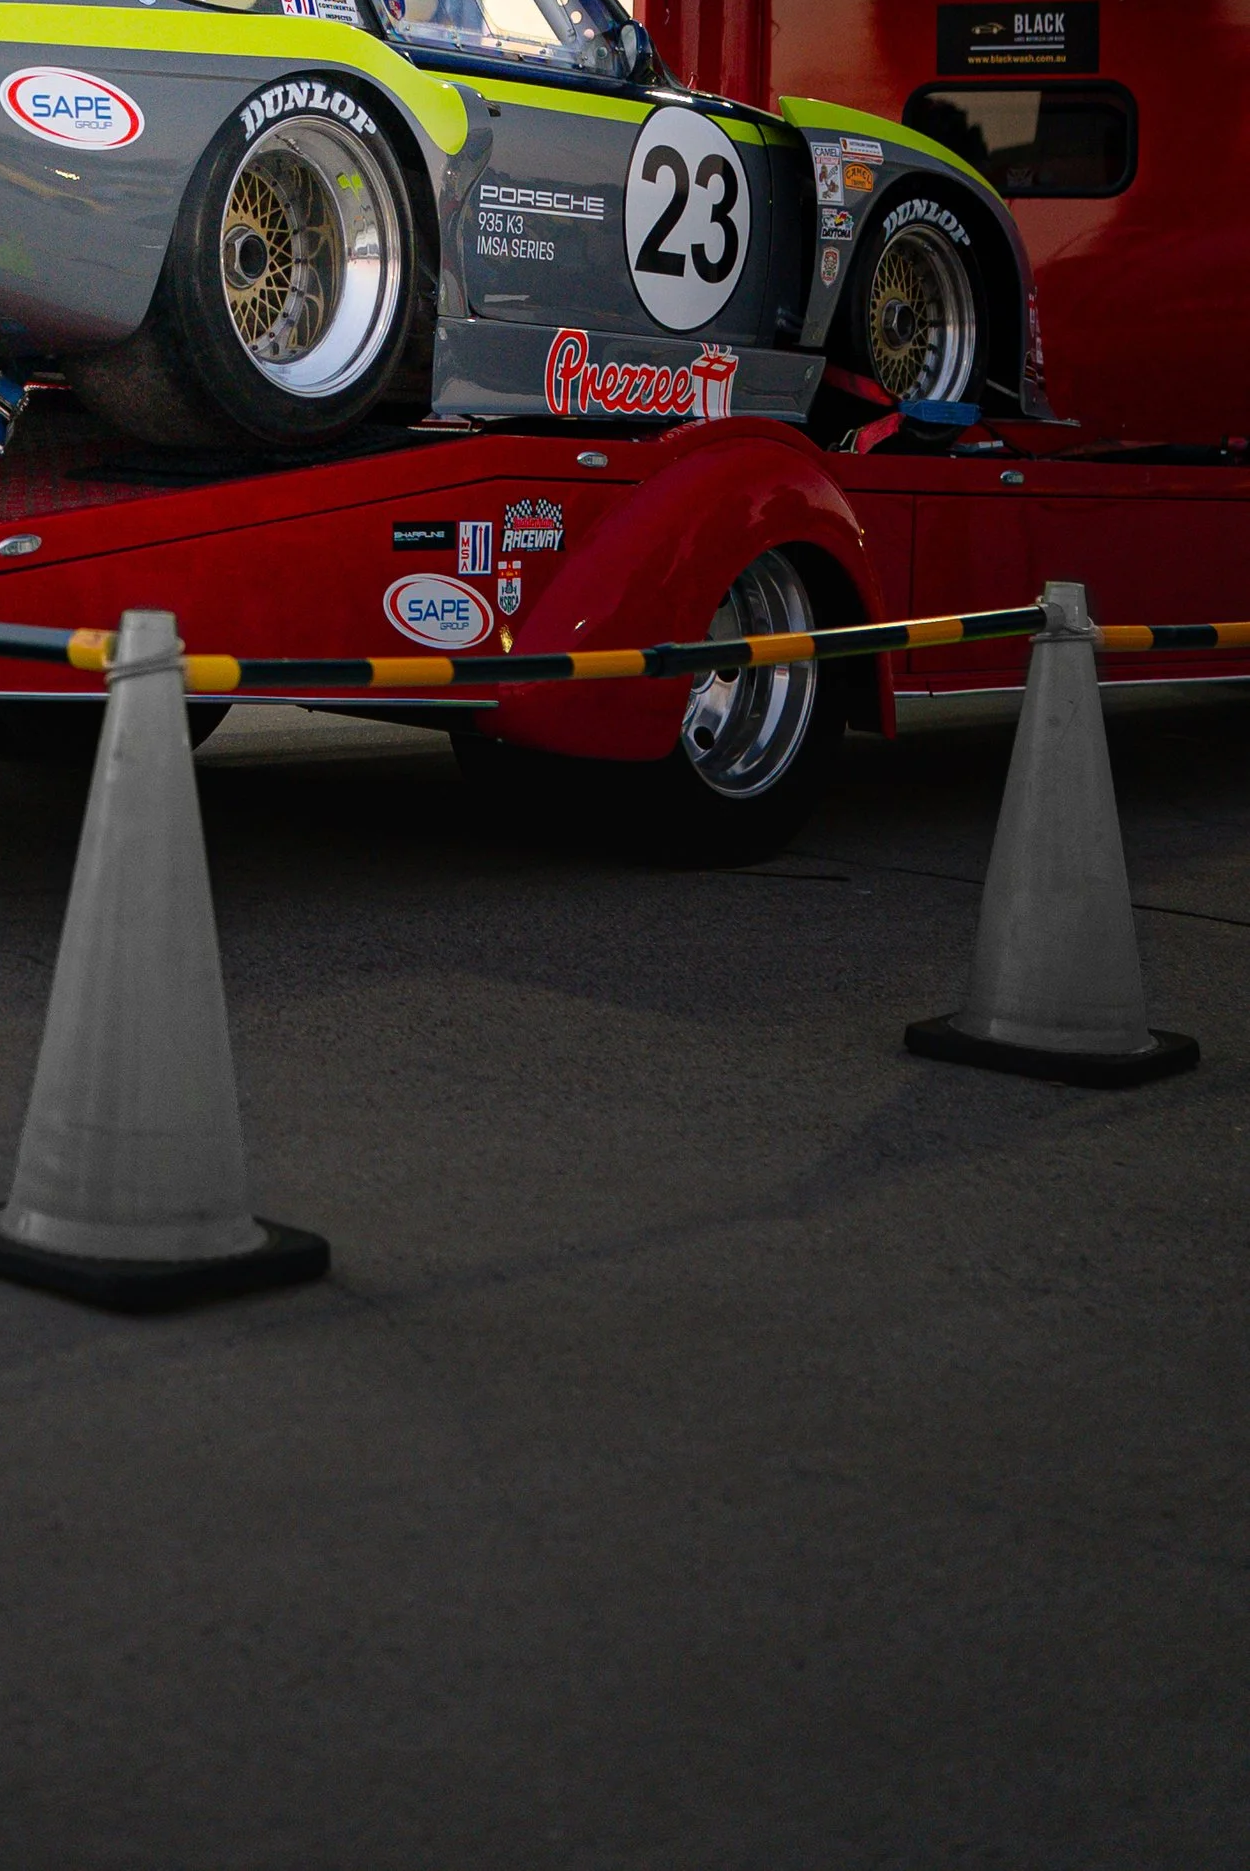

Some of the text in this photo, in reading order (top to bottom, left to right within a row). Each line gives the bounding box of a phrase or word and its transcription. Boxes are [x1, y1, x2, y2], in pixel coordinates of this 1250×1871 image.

[318, 3, 356, 13] CONTINENTAL
[1014, 13, 1065, 34] BLACK
[967, 54, 1067, 64] www.blackwash.com.au
[32, 94, 112, 119] SAPE
[239, 81, 377, 141] DUNLOP
[75, 121, 113, 129] GROUP
[814, 147, 838, 157] CAMEL
[480, 184, 604, 213] PORSCHE
[478, 212, 524, 234] 935 K3
[635, 145, 739, 284] 23
[883, 198, 971, 246] DUNLOP
[822, 228, 851, 238] DAYTONA
[477, 235, 555, 261] IMSA SERIES
[545, 328, 696, 415] Prezzee
[394, 530, 445, 539] SHARPLINE
[502, 529, 563, 552] RACEWAY
[461, 525, 470, 571] IMSA
[408, 600, 470, 621] SAPE
[440, 622, 469, 630] GROUP
